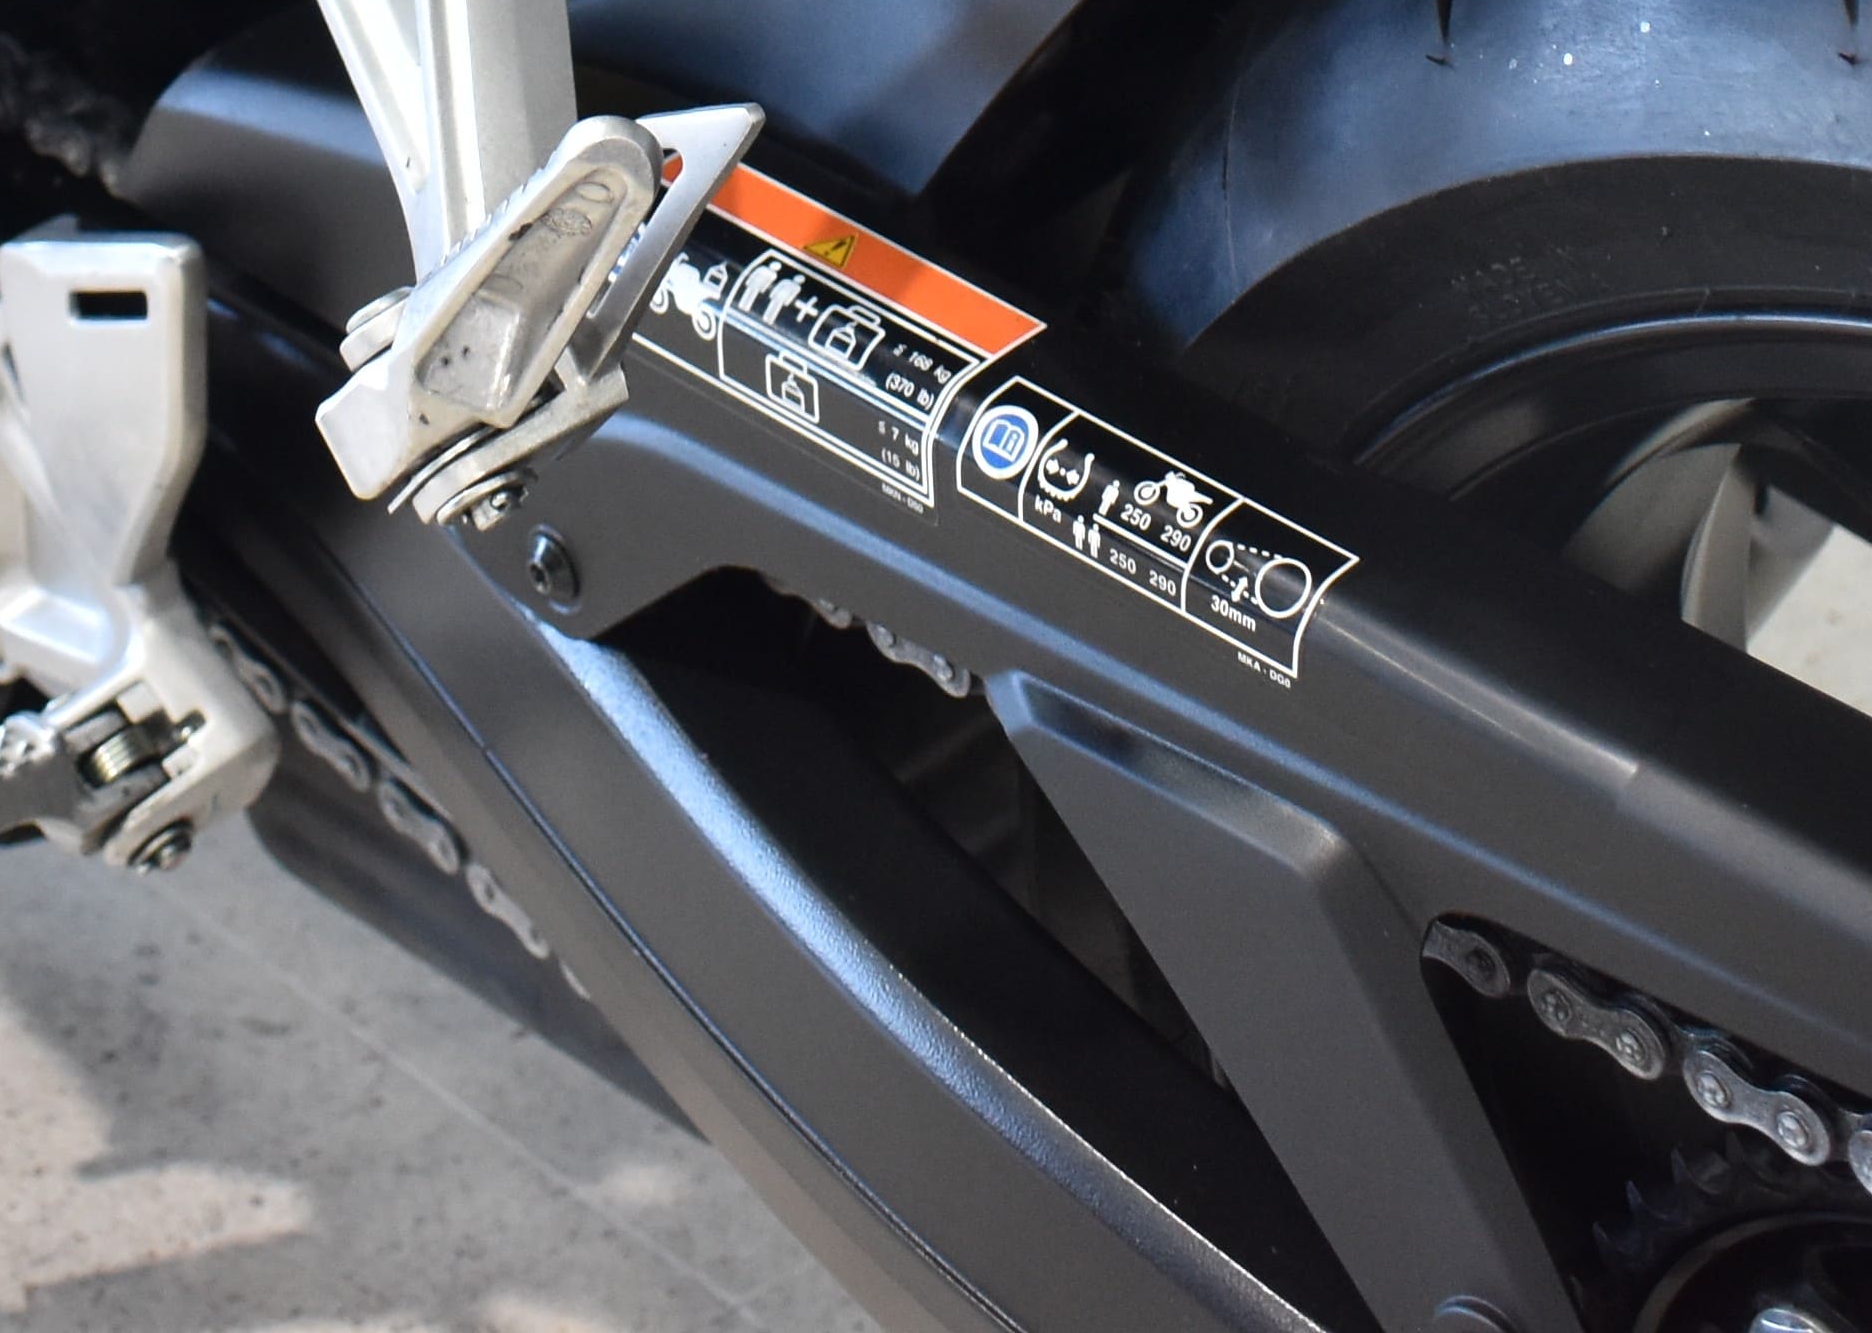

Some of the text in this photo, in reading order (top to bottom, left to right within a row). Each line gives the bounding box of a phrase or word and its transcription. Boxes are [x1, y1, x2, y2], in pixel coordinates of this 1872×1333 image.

[885, 372, 914, 397] (370
[933, 364, 952, 385] kg
[904, 433, 919, 456] kg
[1034, 494, 1062, 523] kPa
[1120, 503, 1191, 552] 250 290
[1109, 548, 1176, 596] 250 290
[1210, 594, 1256, 632] 30mm
